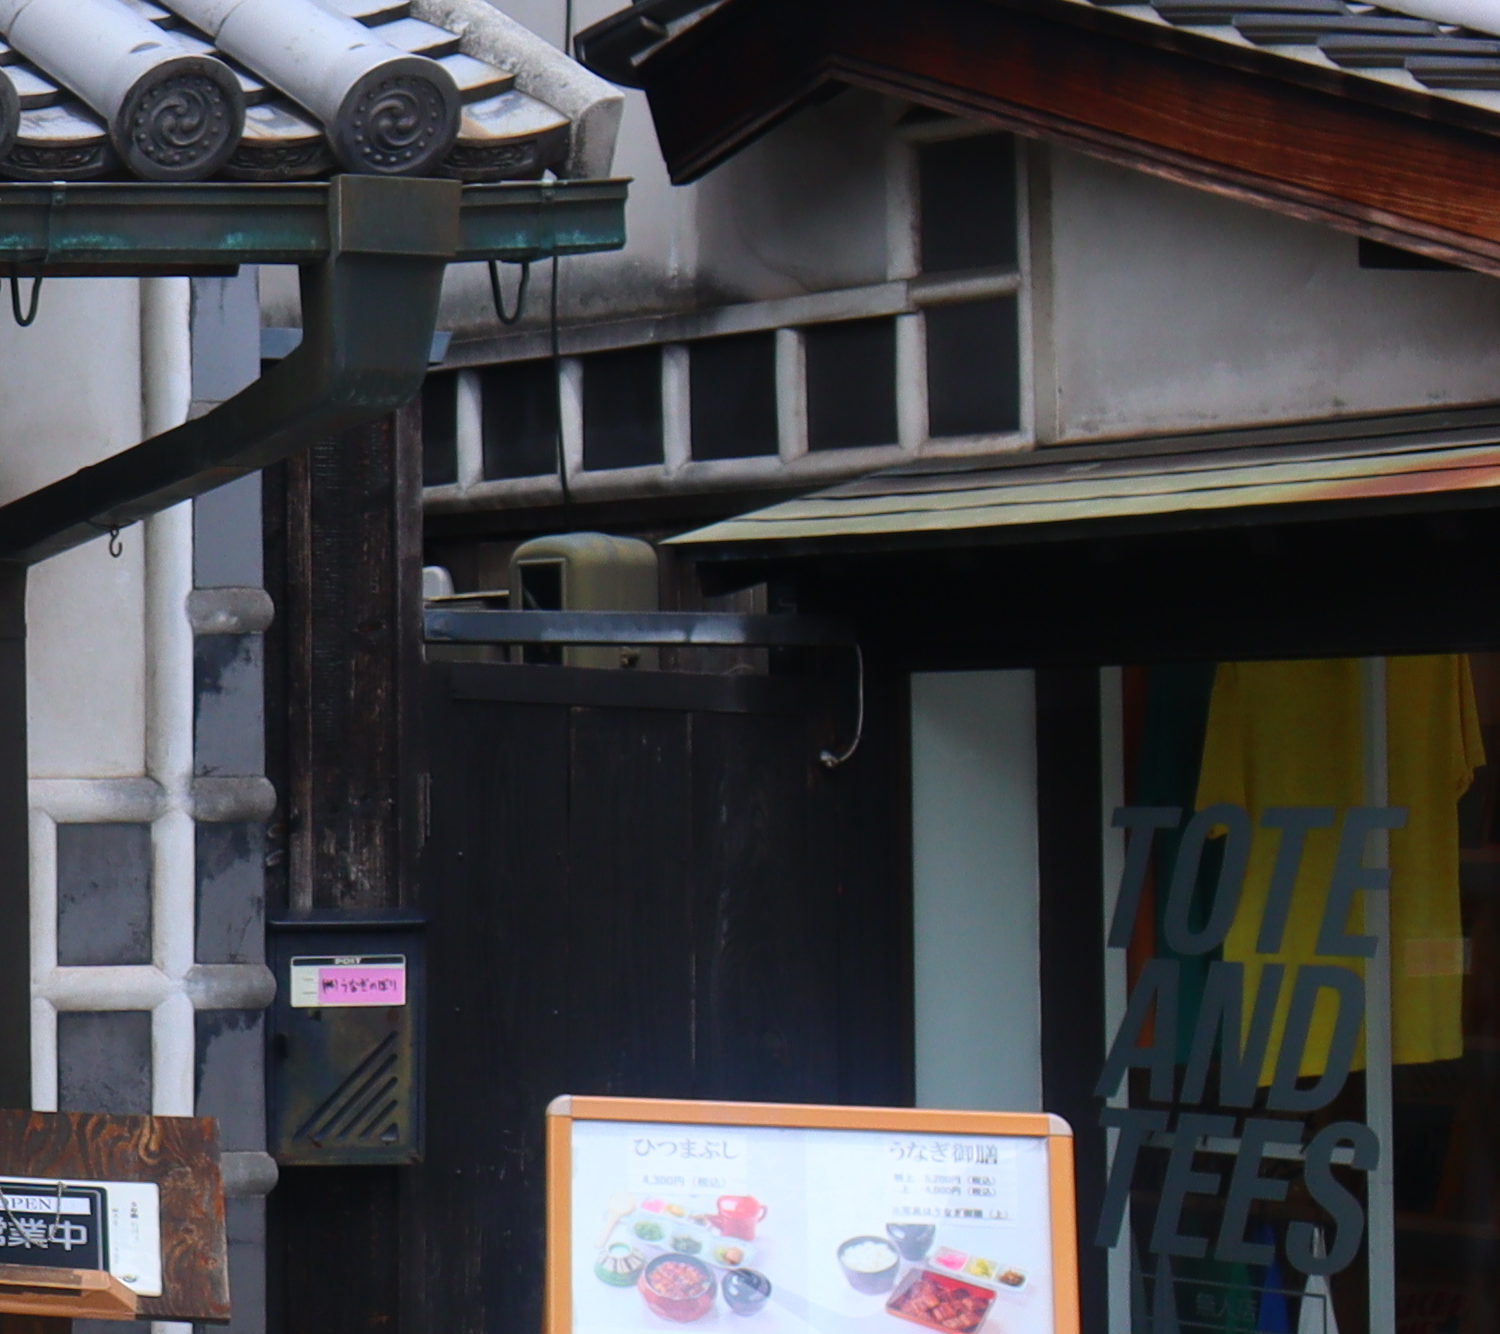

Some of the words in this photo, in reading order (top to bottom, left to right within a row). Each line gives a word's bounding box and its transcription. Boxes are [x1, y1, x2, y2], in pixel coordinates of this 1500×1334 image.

[1108, 805, 1408, 958] TOTE
[1094, 958, 1365, 1113] AND
[633, 1137, 739, 1159] ひつまぶし
[889, 1141, 998, 1164] うなぎ御膳
[1092, 1107, 1380, 1277] TEES
